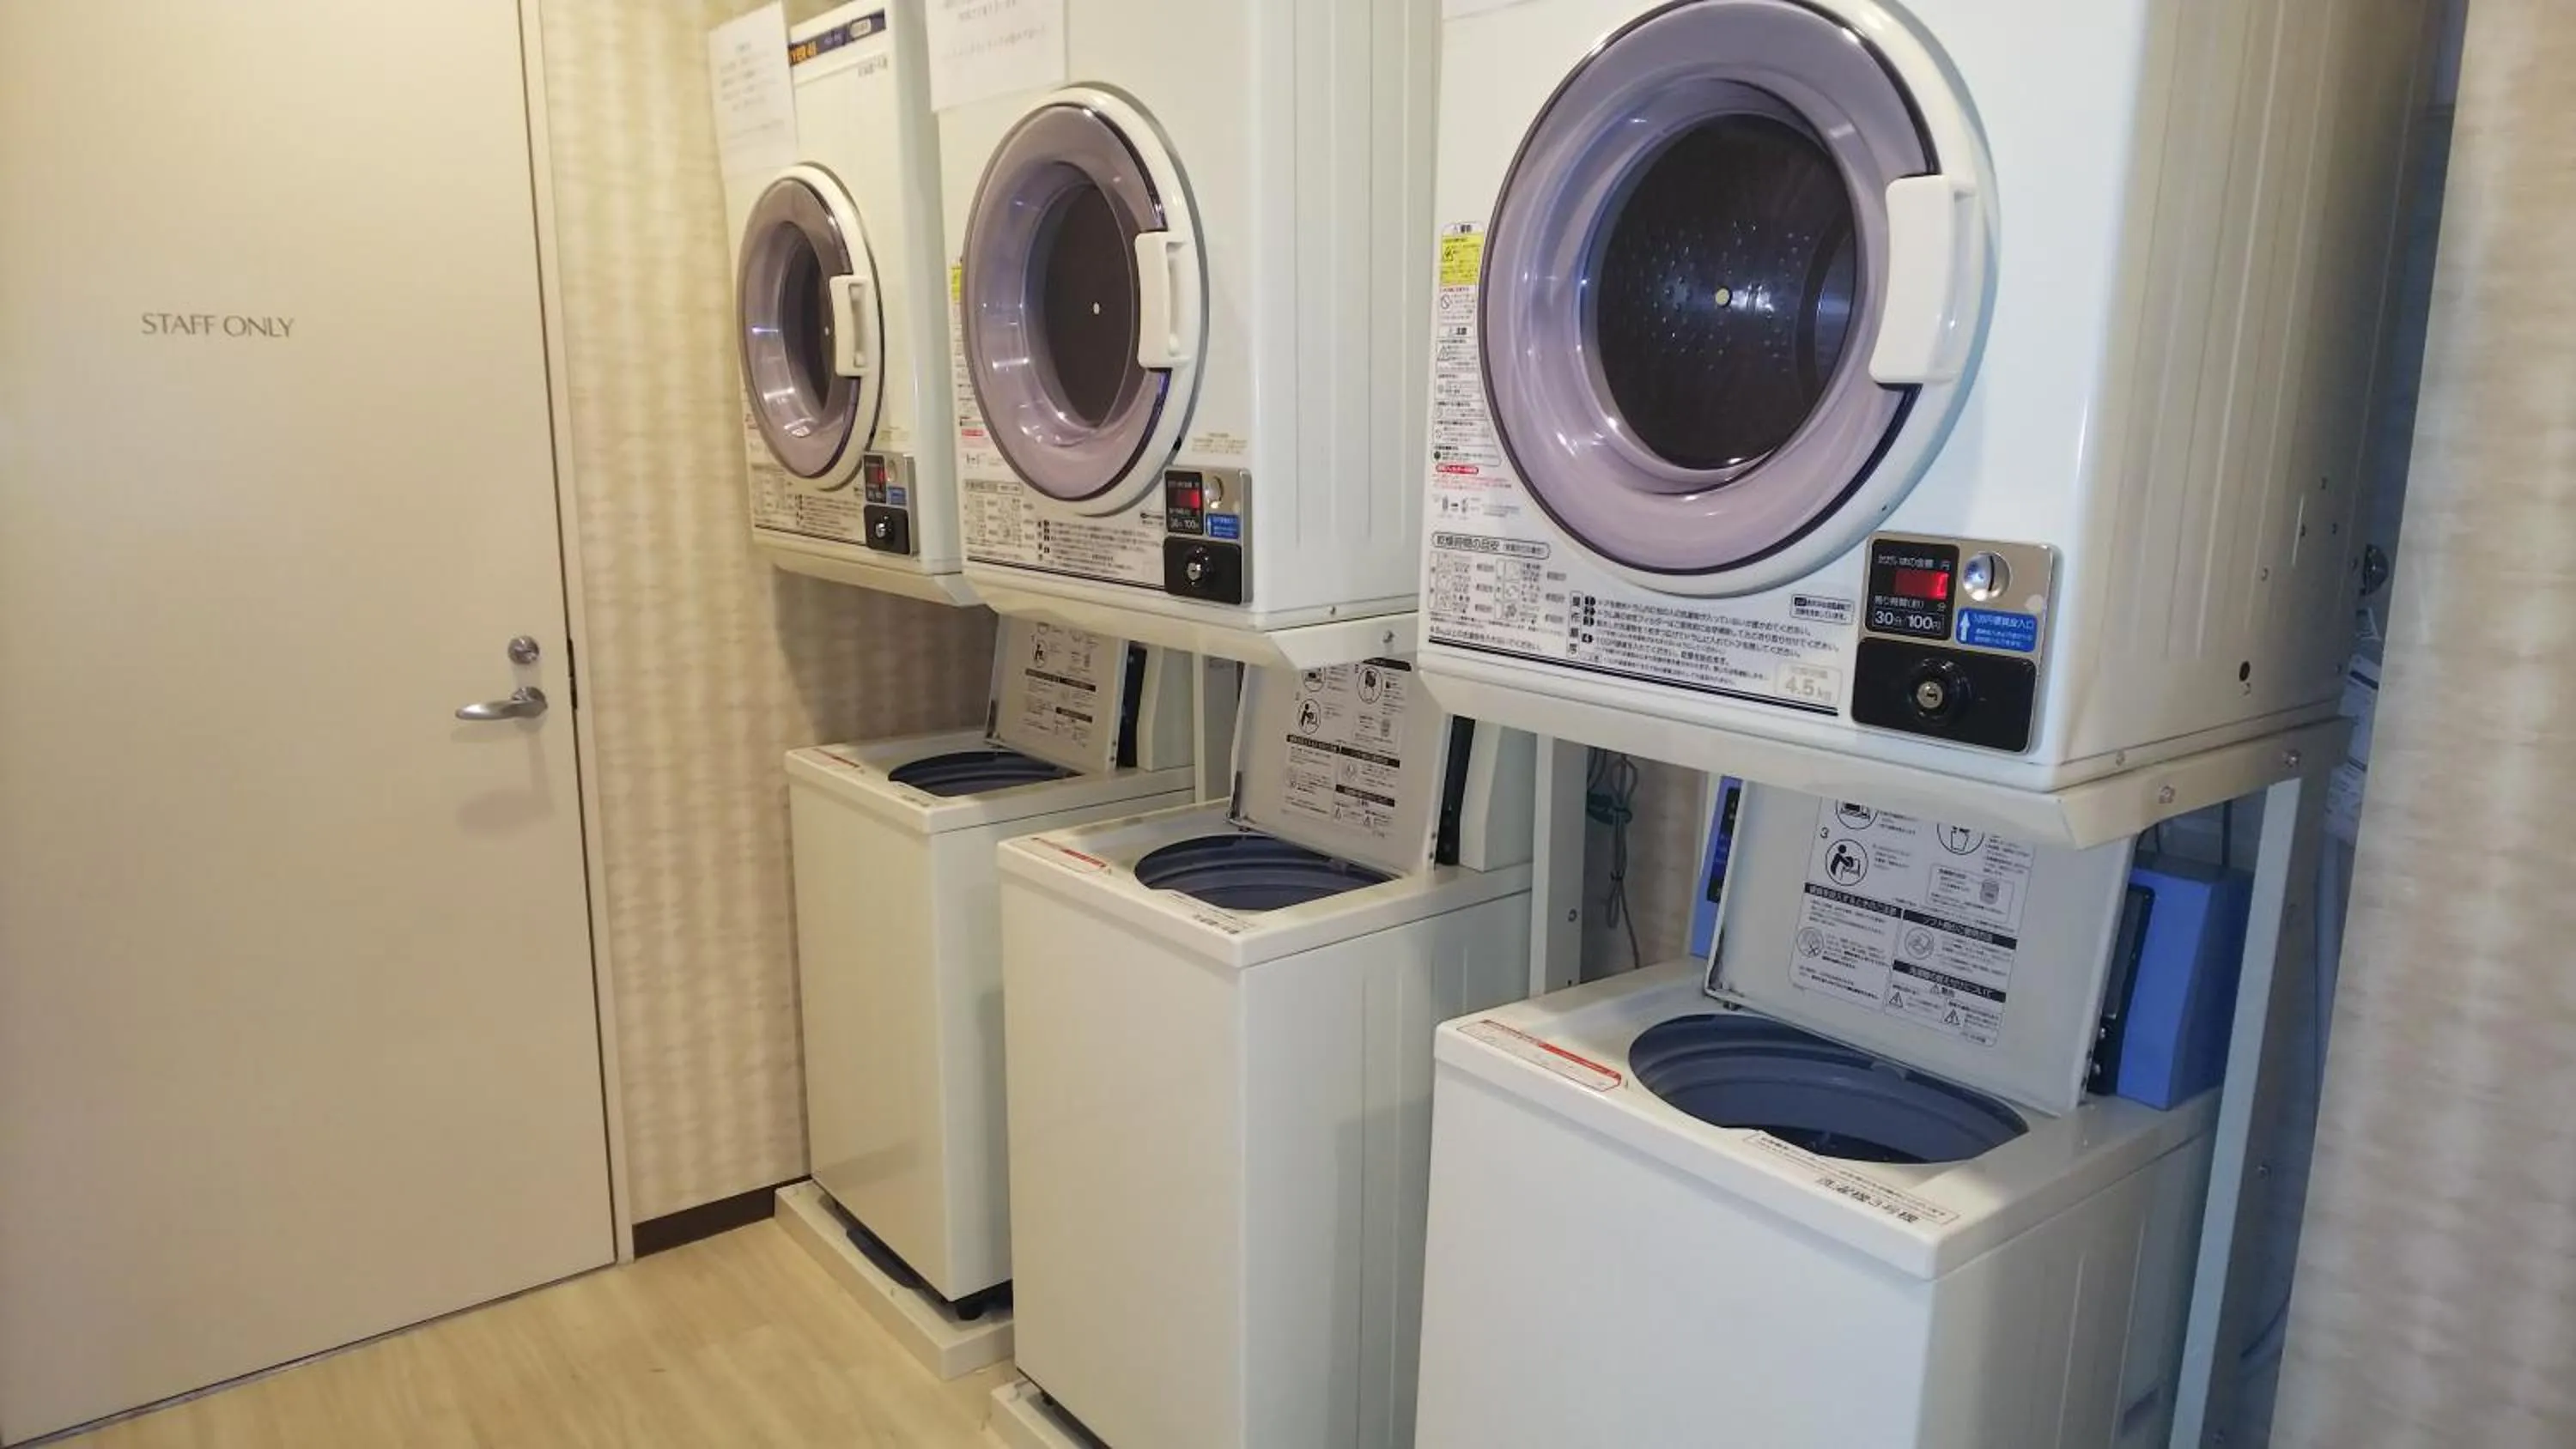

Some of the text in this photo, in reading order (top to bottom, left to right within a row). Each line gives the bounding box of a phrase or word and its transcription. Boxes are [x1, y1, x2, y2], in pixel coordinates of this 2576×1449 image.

[141, 312, 295, 338] STAFF ONLY
[1820, 827, 1830, 839] 3
